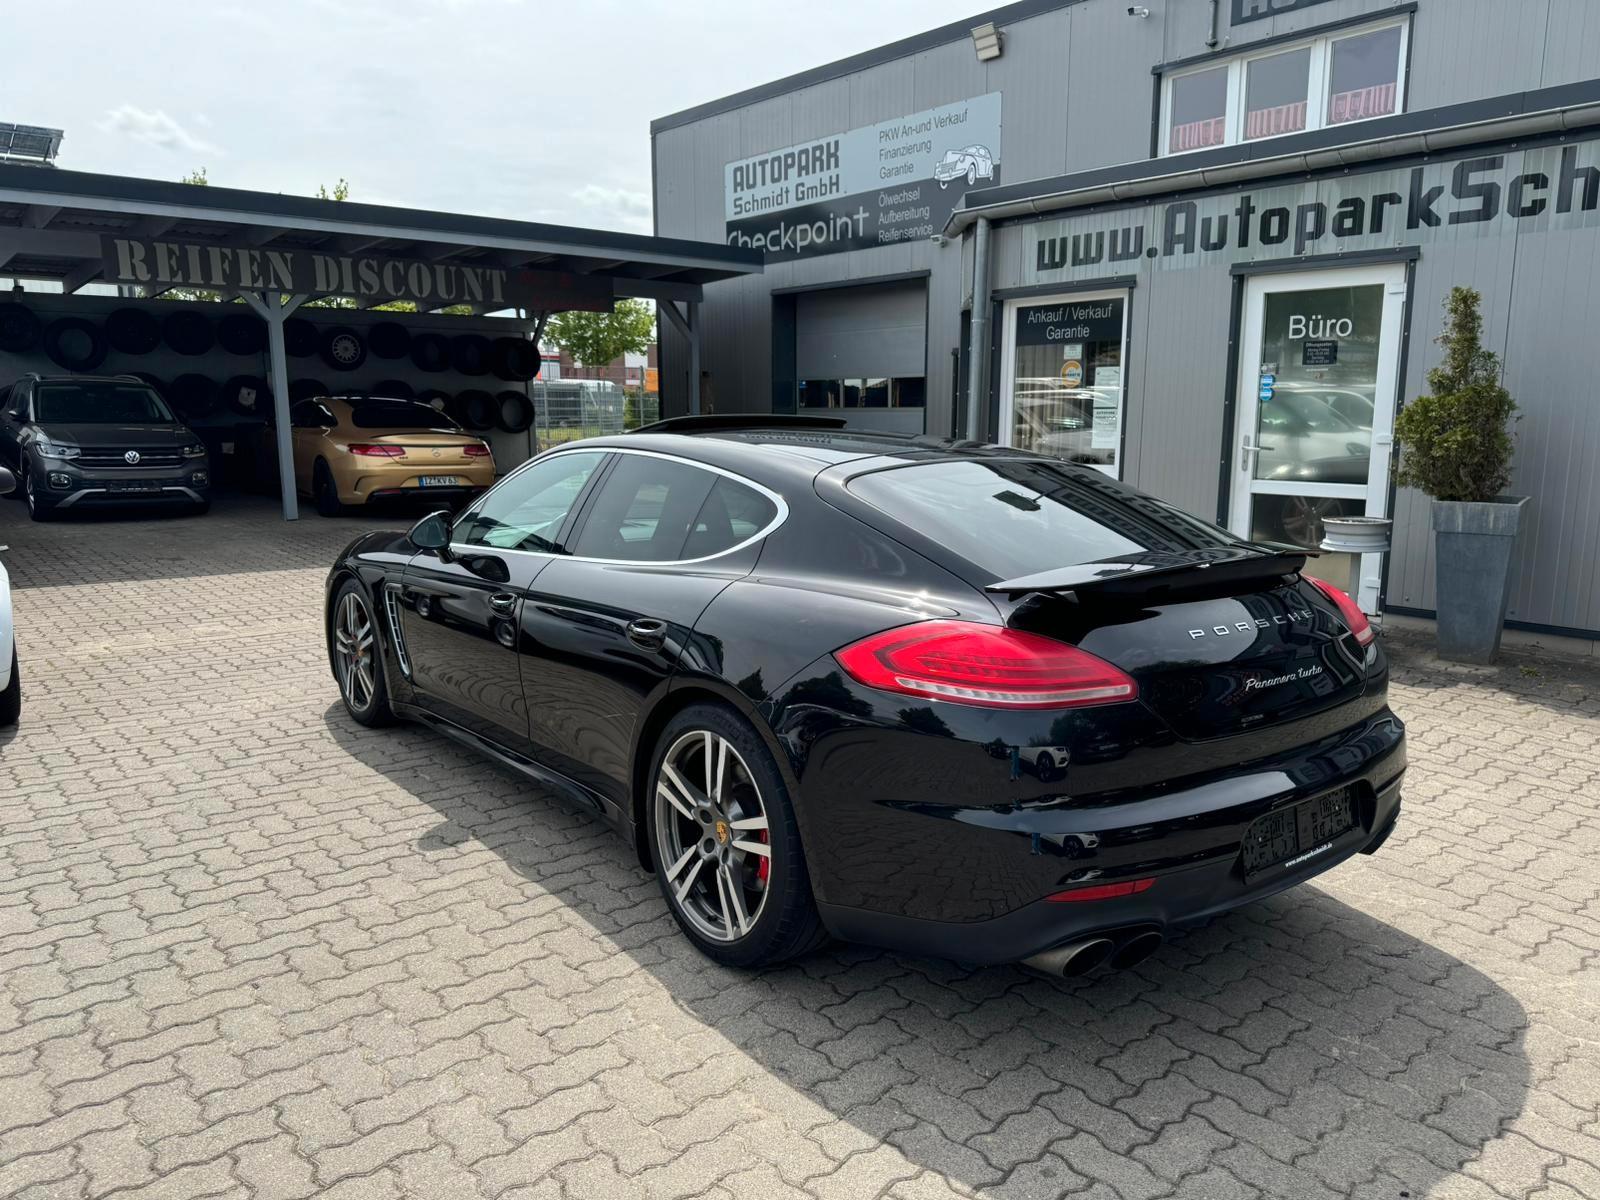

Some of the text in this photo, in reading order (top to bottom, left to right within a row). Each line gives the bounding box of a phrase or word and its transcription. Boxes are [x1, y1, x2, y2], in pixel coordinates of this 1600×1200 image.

[879, 123, 900, 143] PKW
[933, 108, 968, 129] Verkauf
[879, 139, 932, 161] Finanzierung
[733, 140, 839, 193] AUTOPARK
[879, 162, 914, 180] Garantie
[733, 174, 839, 215] Schmidt GmbH
[878, 187, 920, 207] Ölwechsel
[878, 205, 930, 226] Aufbereitung
[878, 225, 933, 243] Reifenservice
[113, 239, 294, 290] REIFEN
[312, 254, 507, 303] DISCOUNT
[1028, 308, 1063, 324] Ankauf
[1071, 304, 1113, 321] Verkauf
[1046, 324, 1090, 341] Garantie
[1288, 314, 1353, 339] Büro
[1189, 609, 1314, 640] PORSCHE
[1245, 673, 1297, 691] Panamera
